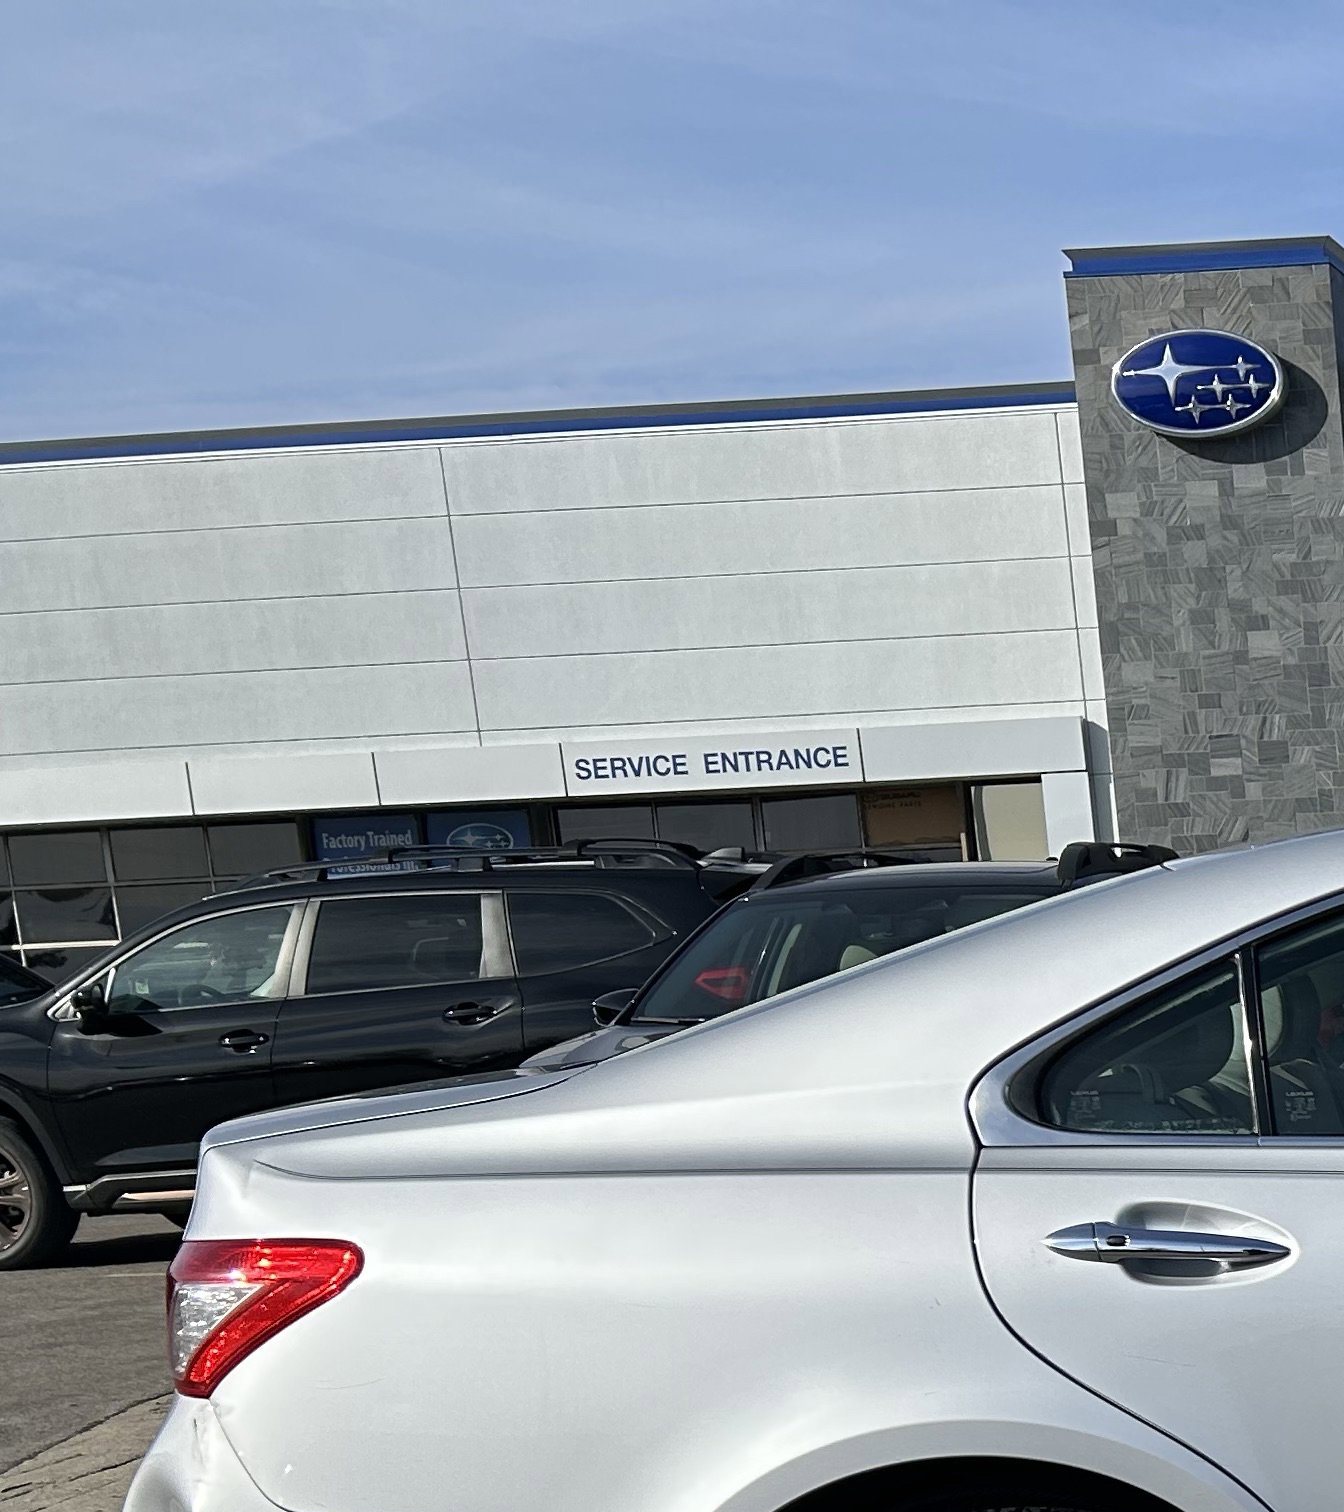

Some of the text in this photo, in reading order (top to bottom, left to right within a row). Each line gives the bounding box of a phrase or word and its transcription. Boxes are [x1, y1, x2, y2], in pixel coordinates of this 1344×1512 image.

[574, 746, 849, 780] SERVICE ENTRANCE
[322, 830, 413, 851] Factory Trained
